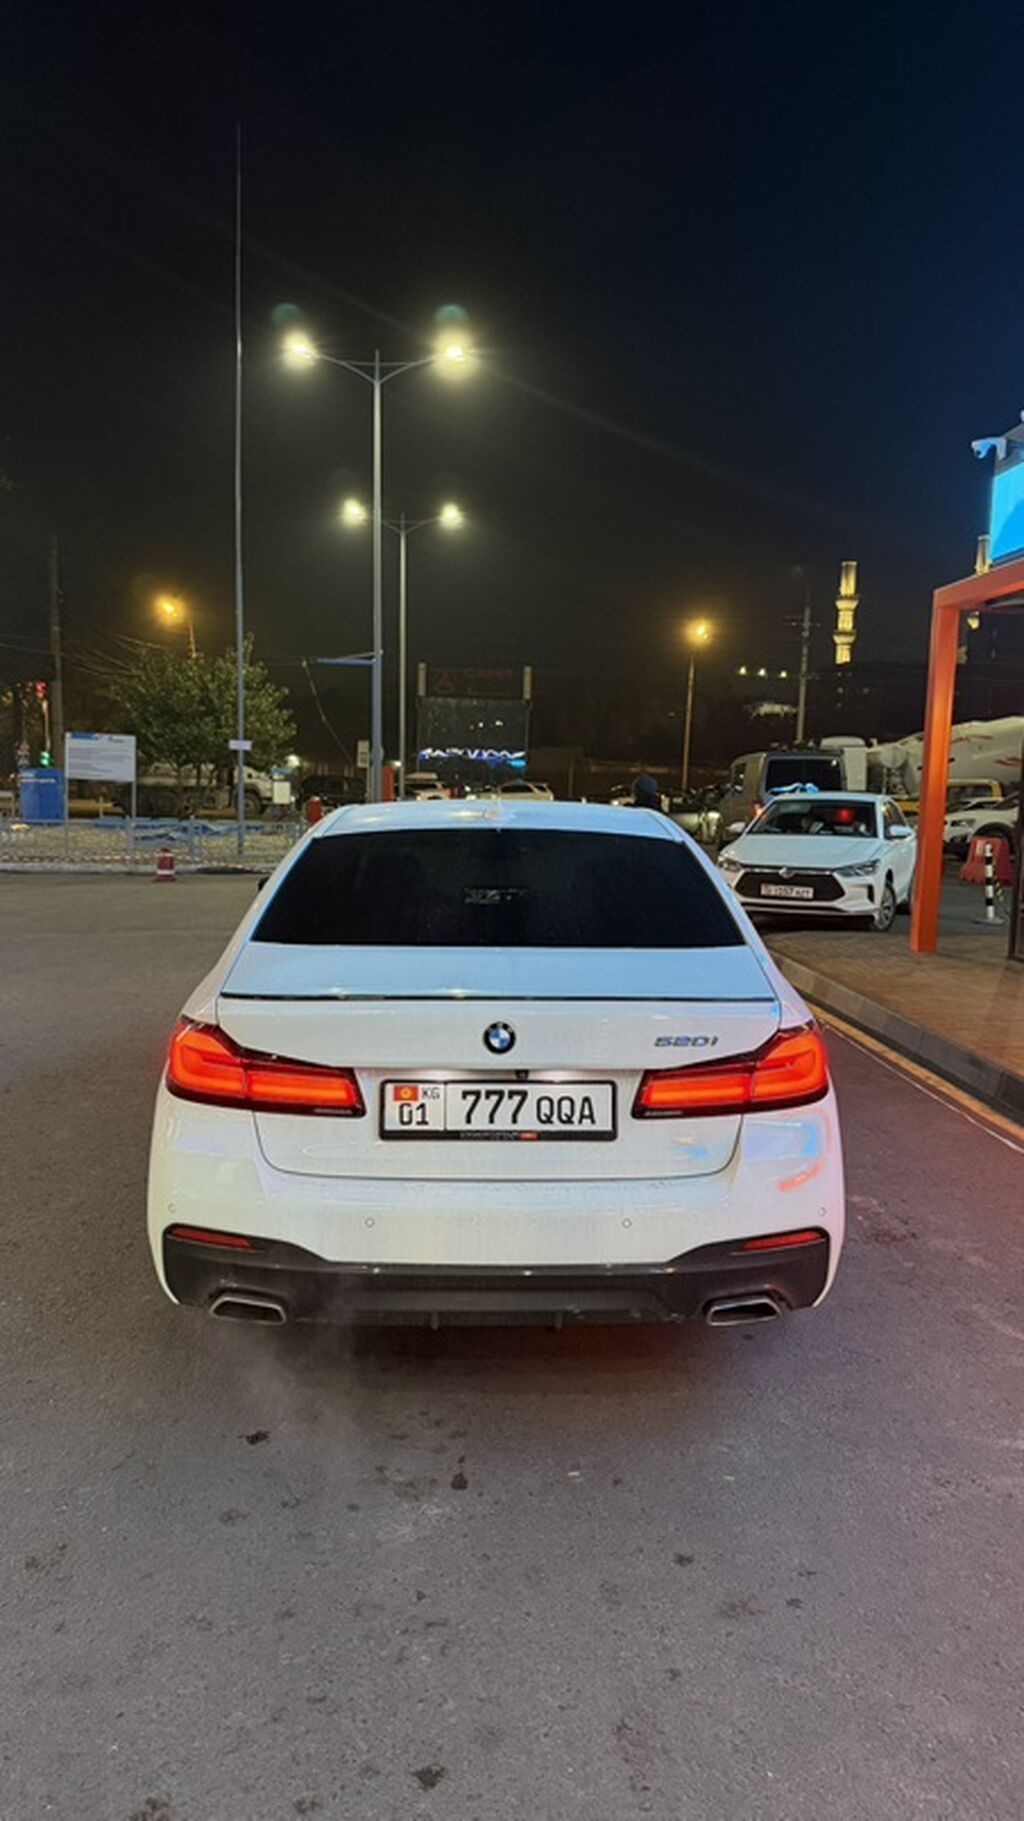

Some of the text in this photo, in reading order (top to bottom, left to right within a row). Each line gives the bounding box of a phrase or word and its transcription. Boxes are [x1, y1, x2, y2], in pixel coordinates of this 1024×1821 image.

[422, 1087, 440, 1100] KG
[399, 1103, 429, 1126] 01
[462, 1089, 596, 1125] 777 QQA
